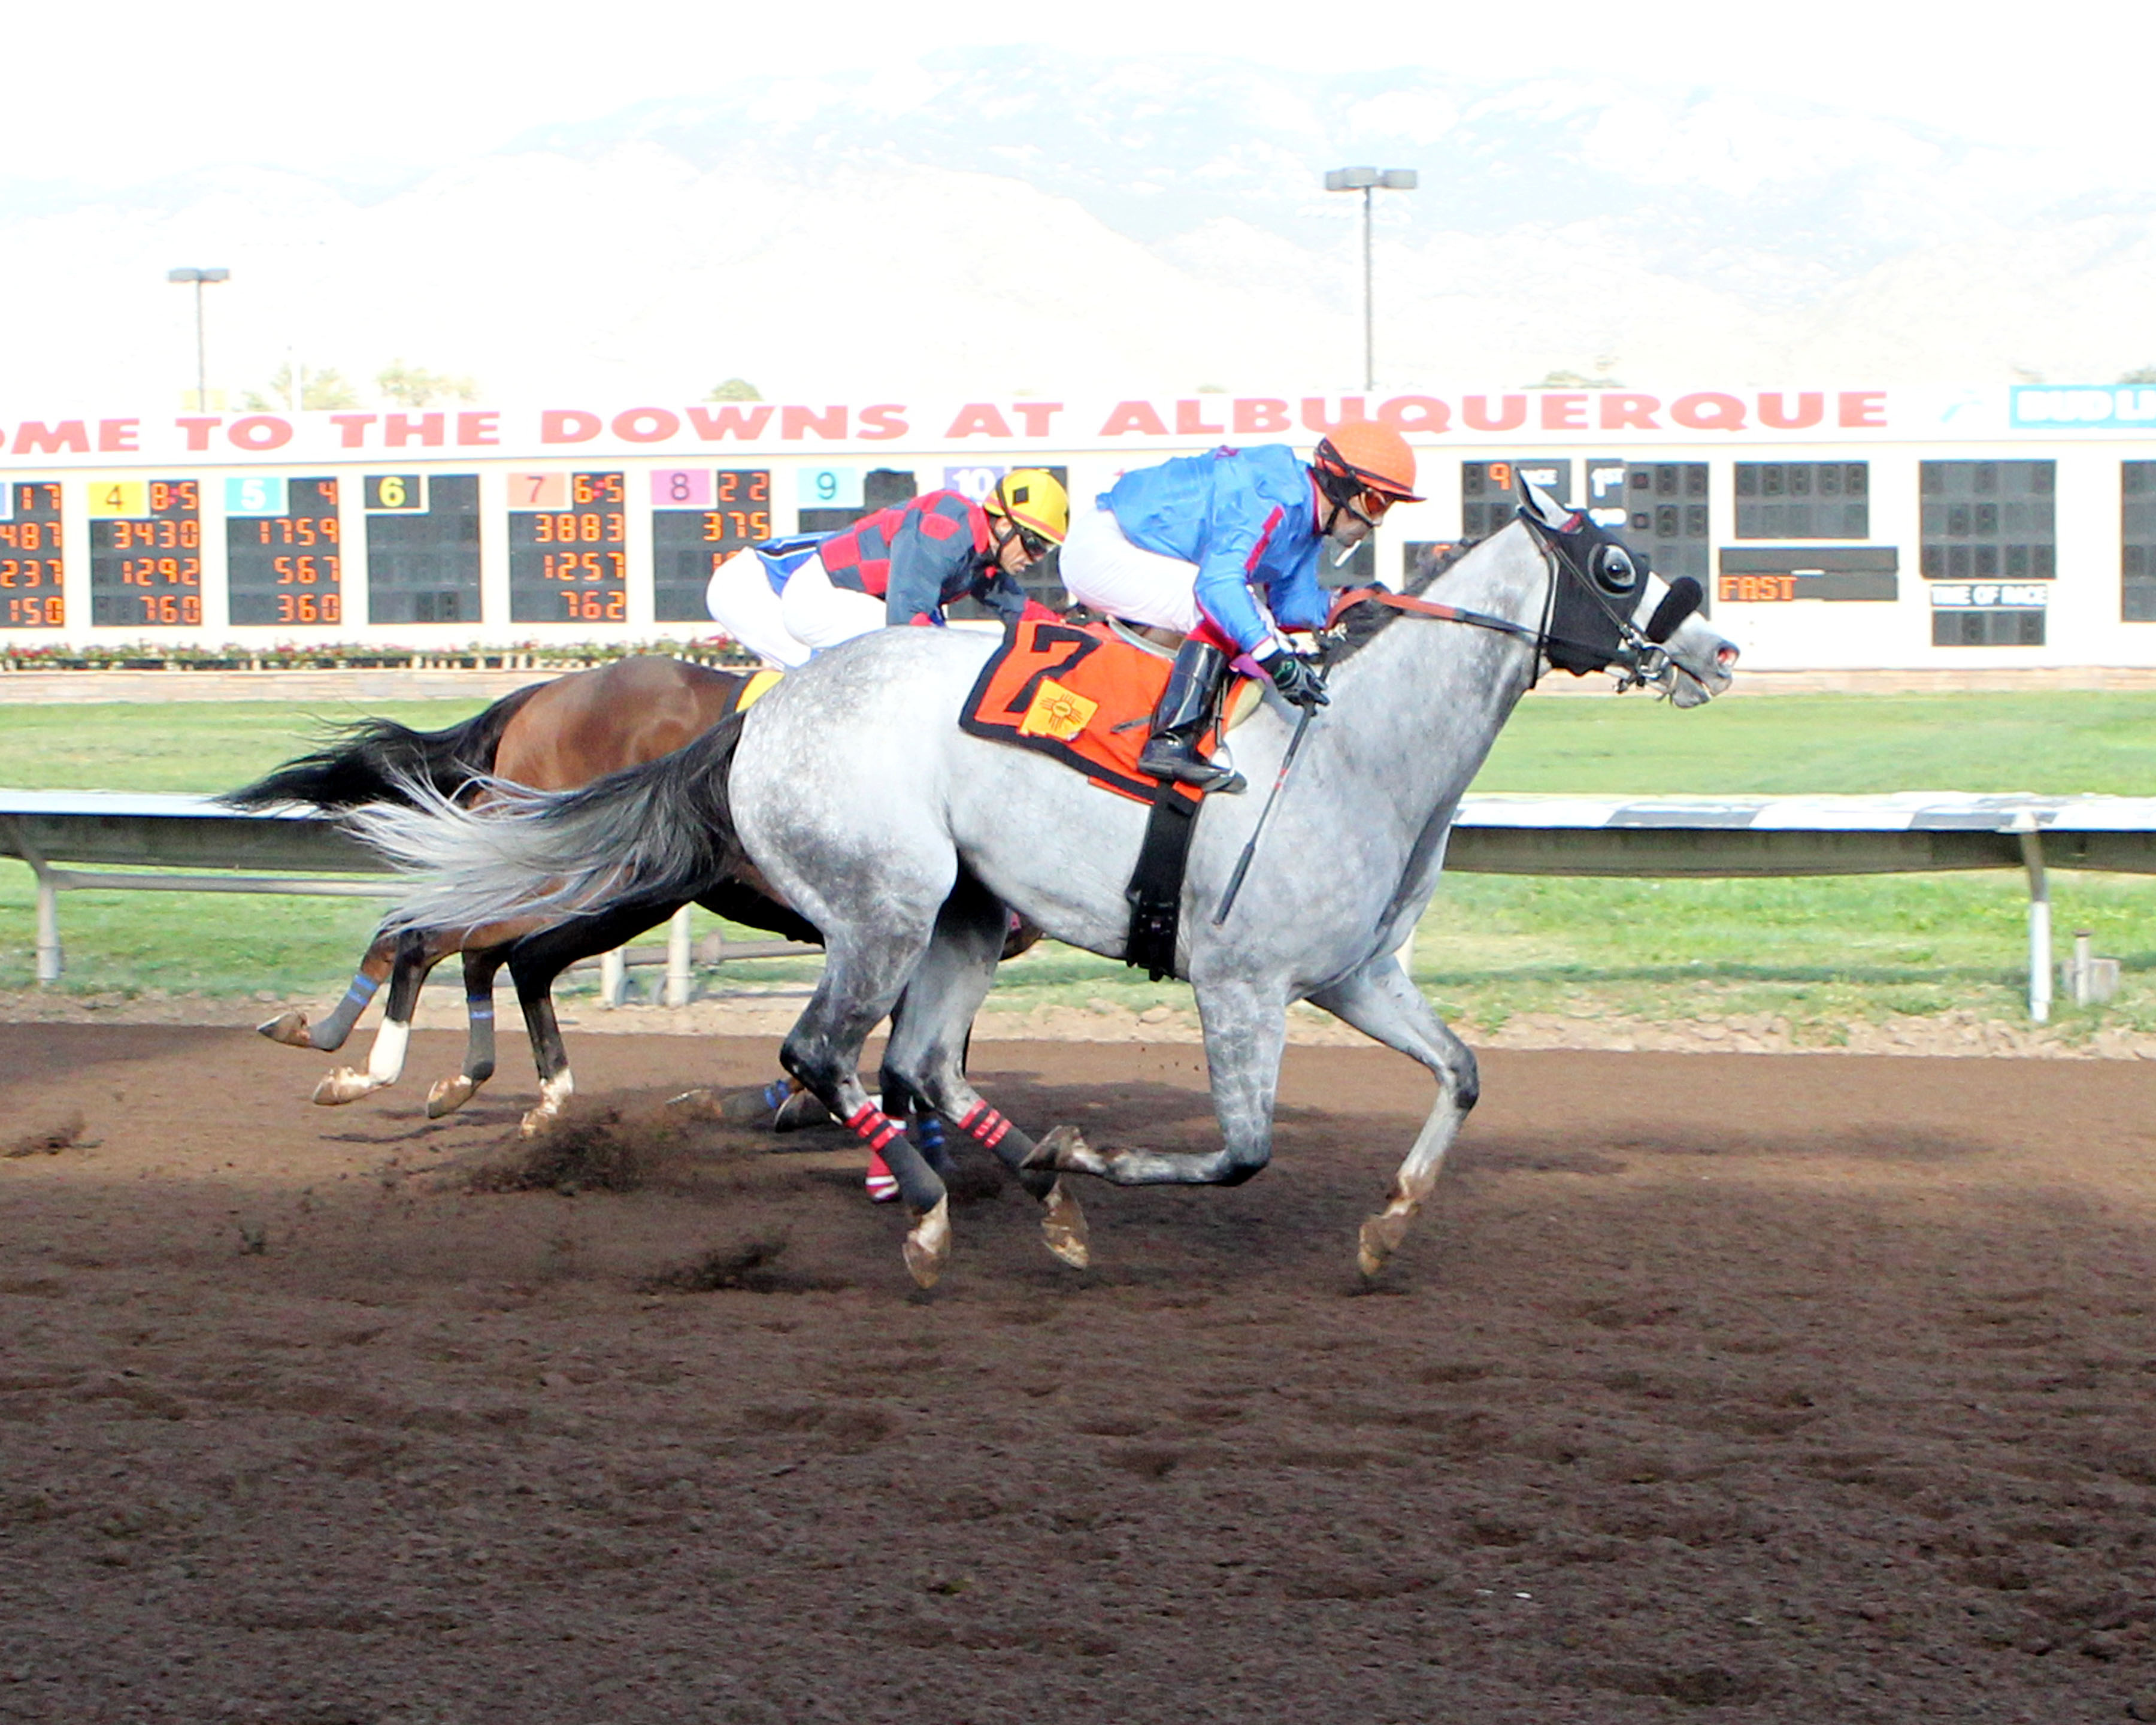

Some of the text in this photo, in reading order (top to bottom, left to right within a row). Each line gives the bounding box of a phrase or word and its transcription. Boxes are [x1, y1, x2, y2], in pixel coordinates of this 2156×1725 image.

[0, 392, 1886, 454] ME TO THE DOWNS AT ALBUQUERQUE
[526, 476, 546, 504] 7
[670, 472, 690, 501] 8
[816, 471, 837, 500] 9
[952, 467, 997, 500] 10
[1489, 463, 1511, 490] 9
[105, 485, 124, 511] 4
[241, 479, 266, 510] 5
[319, 481, 337, 505] 4
[378, 477, 406, 507] 6
[114, 519, 198, 549] 3430
[260, 517, 338, 546] 1759
[535, 512, 625, 543] 3883
[703, 511, 770, 541] 375
[123, 557, 199, 586] 1292
[274, 555, 339, 585] 567
[544, 551, 625, 581] 1257
[1720, 575, 1797, 600] FAST
[10, 596, 63, 625] 150
[141, 595, 199, 625] 760
[279, 593, 340, 624] 360
[561, 590, 625, 620] 762
[1006, 624, 1103, 713] 7
